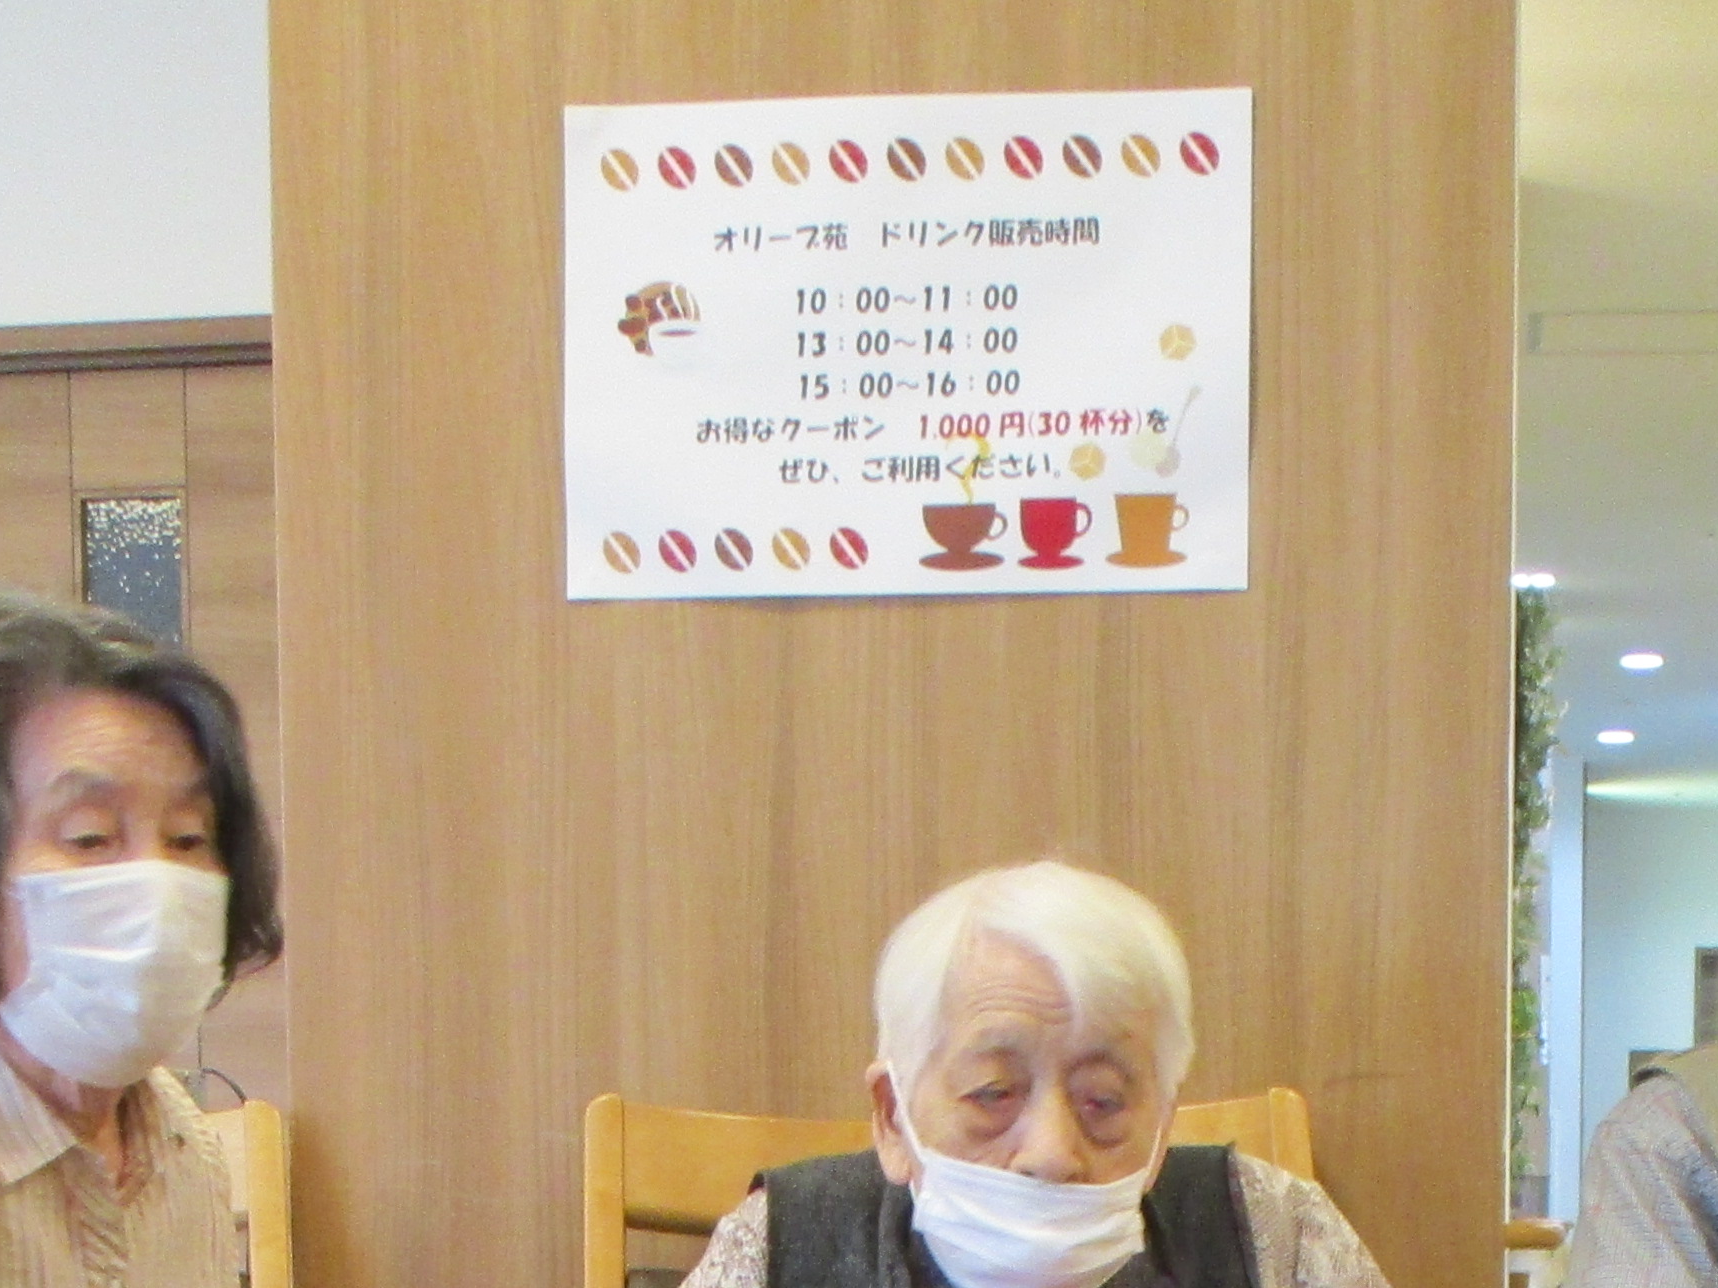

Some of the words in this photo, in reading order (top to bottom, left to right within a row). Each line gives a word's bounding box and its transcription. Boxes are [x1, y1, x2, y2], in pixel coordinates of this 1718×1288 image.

[713, 221, 848, 253] オリーブ苑
[881, 215, 1101, 248] ドリンク販売時間
[696, 414, 885, 445] お得なクーポン
